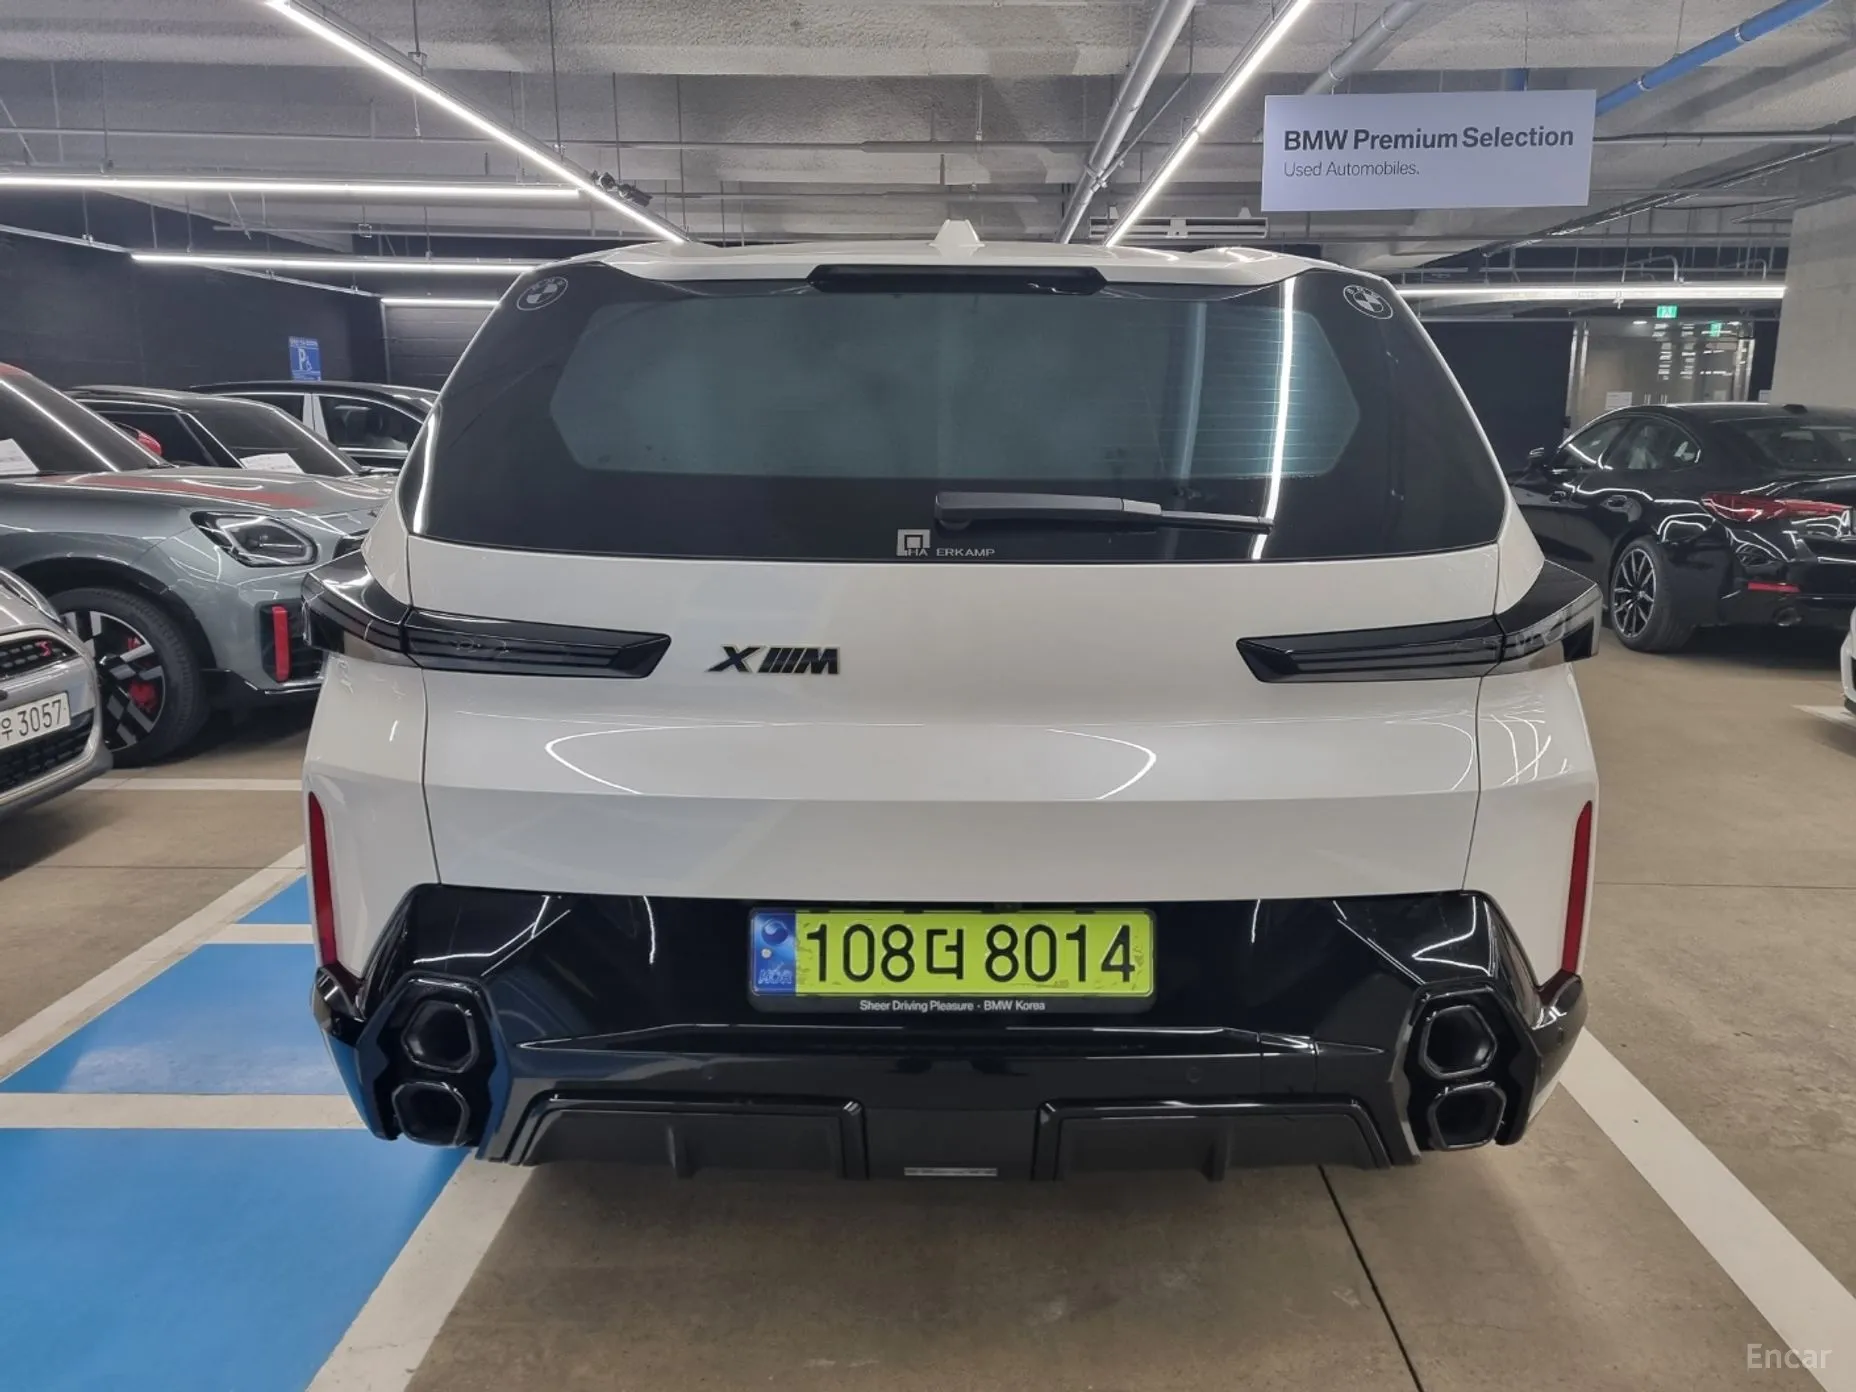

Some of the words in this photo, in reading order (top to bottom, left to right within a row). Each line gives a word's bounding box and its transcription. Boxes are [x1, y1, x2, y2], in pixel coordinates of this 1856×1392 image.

[1284, 129, 1348, 151] BMW
[1353, 127, 1458, 150] Premium
[1462, 125, 1574, 148] Selection
[1284, 160, 1322, 177] Used
[1325, 158, 1420, 176] Automobiles.
[17, 699, 61, 736] 3057
[806, 923, 964, 982] 108더
[985, 923, 1136, 982] 8014
[859, 1000, 890, 1011] Sheer
[892, 1000, 928, 1013] Driving
[929, 1000, 974, 1012] Pleasure
[984, 1000, 1012, 1011] BMW
[1015, 1000, 1045, 1012] Korea
